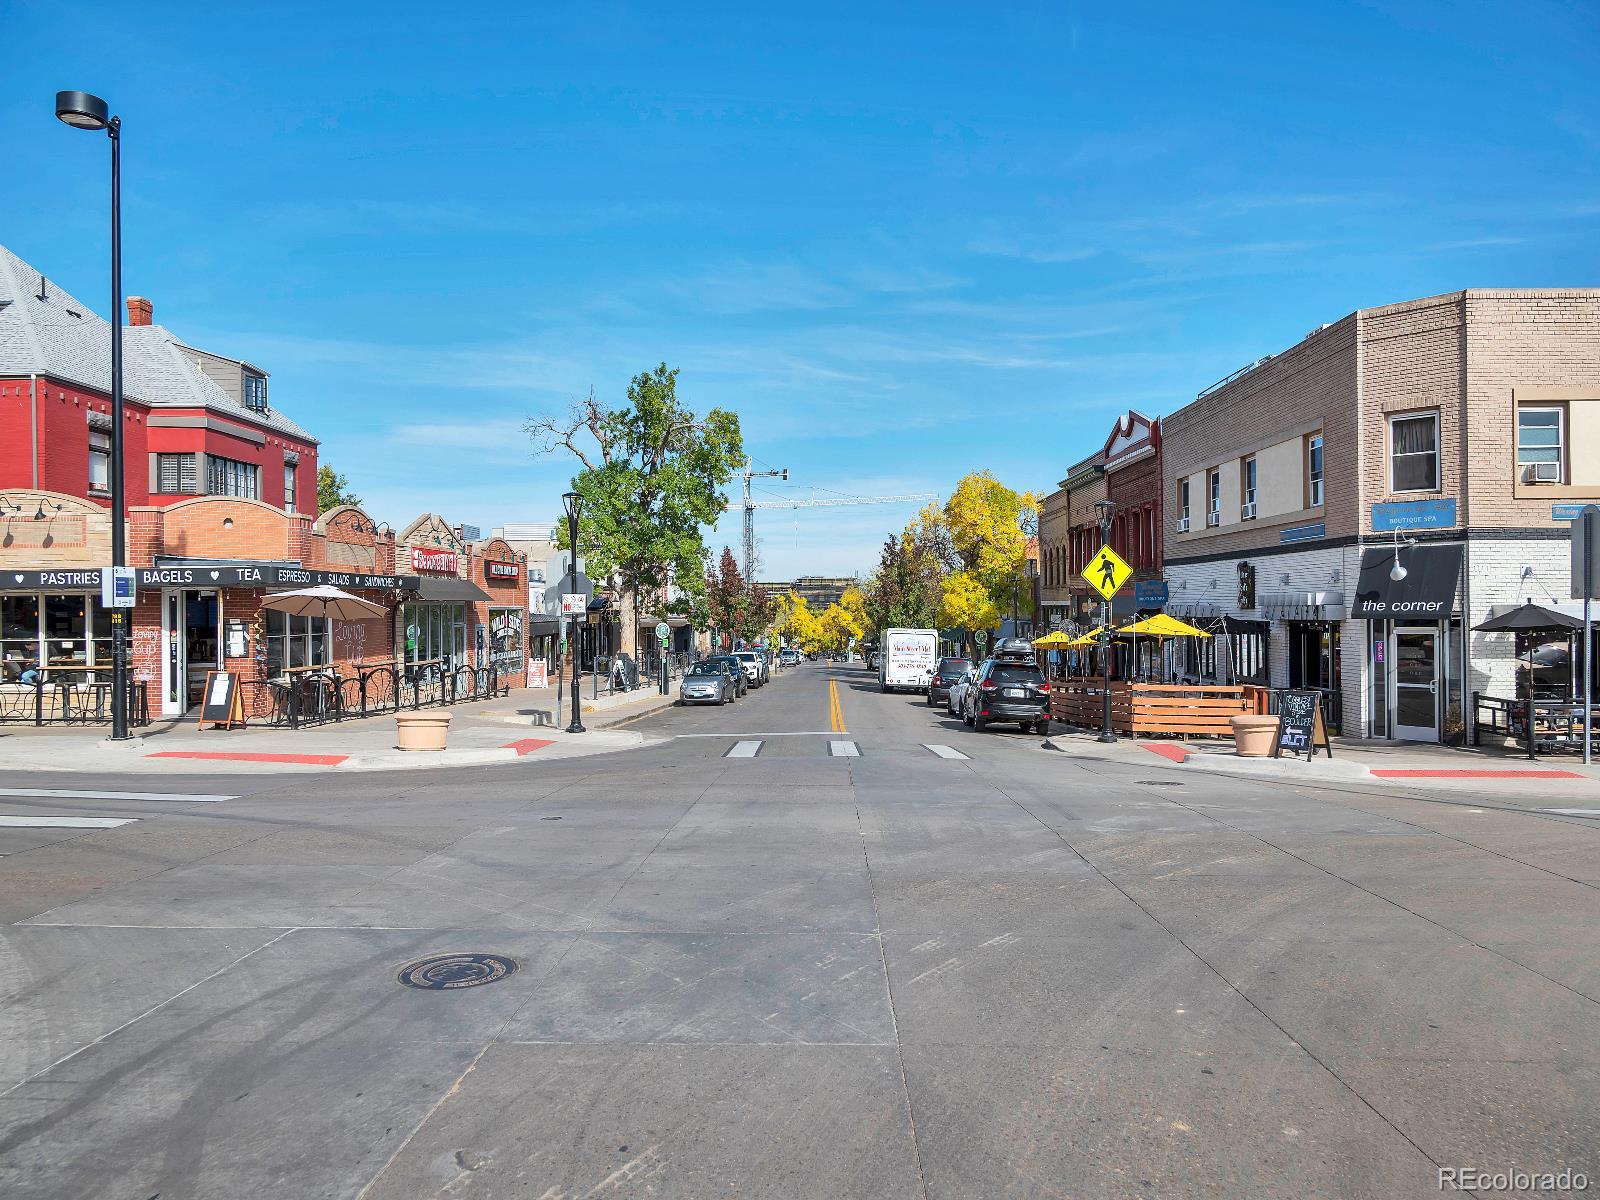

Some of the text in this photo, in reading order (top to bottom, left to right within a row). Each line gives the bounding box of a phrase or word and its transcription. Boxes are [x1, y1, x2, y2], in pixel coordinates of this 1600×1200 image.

[40, 568, 262, 585] PASTRIES BAGELS TEA
[278, 569, 311, 583] ESPRESSO
[328, 573, 350, 585] SALADS
[364, 576, 395, 588] SANDWICHES
[1362, 600, 1443, 611] the corner
